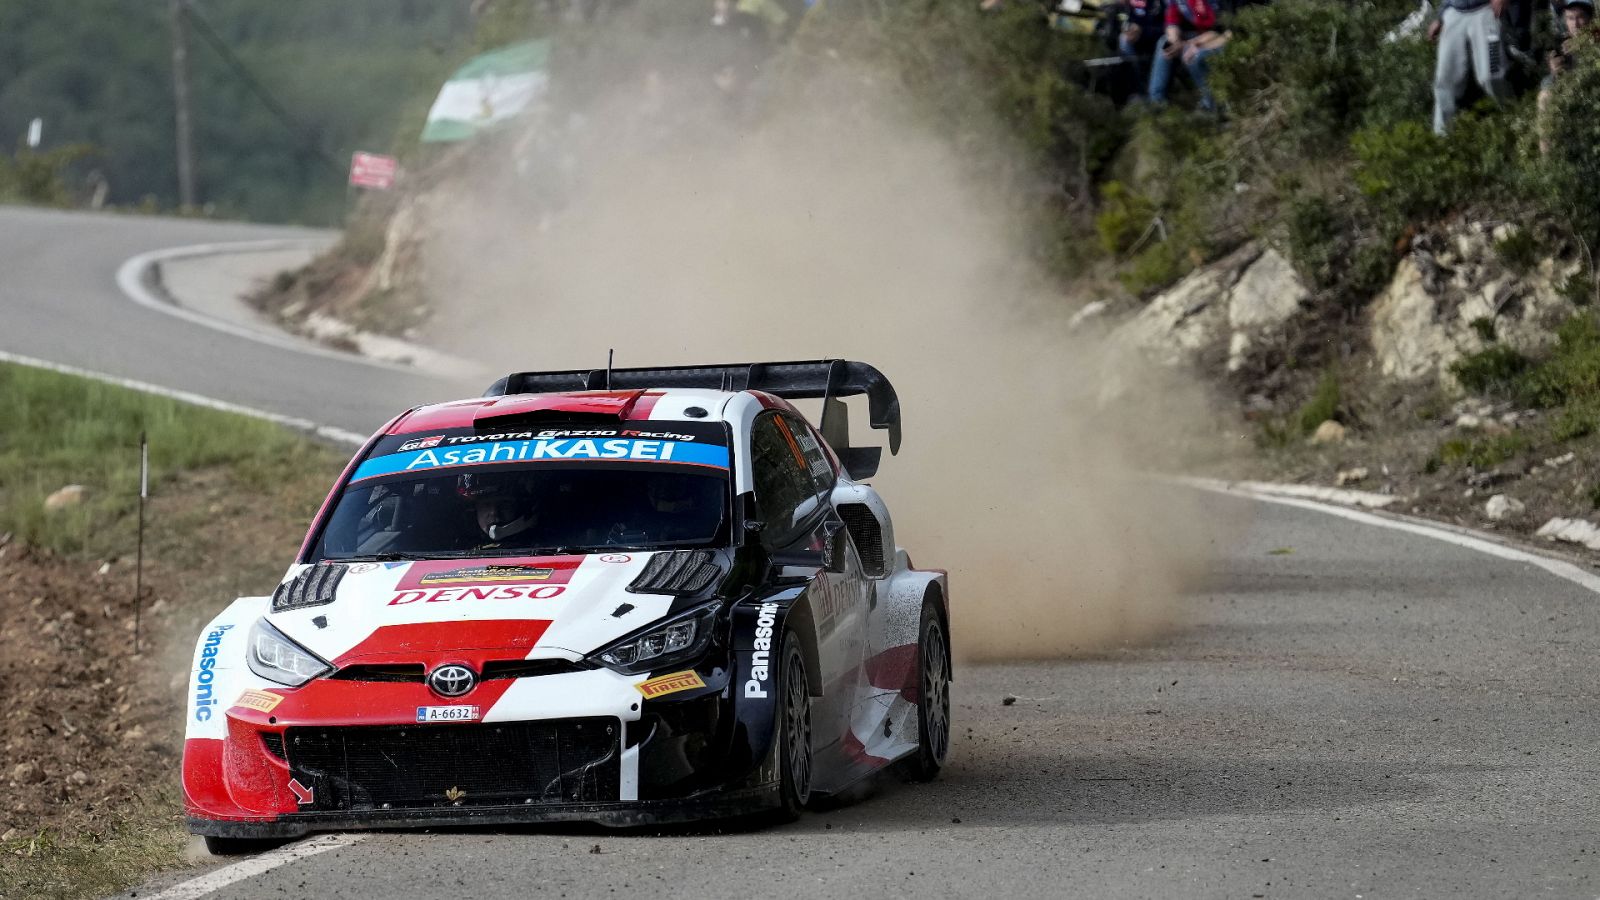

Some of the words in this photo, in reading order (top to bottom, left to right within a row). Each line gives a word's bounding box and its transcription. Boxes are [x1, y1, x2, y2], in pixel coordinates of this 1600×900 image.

[448, 432, 532, 443] TOYOTA
[533, 430, 618, 439] GAZOO
[621, 430, 696, 441] Racing
[387, 586, 566, 606] DENSO
[745, 603, 779, 699] Panasonic
[195, 624, 235, 722] Panasonic
[640, 672, 698, 696] PIRELLI
[236, 691, 277, 709] PIRELLI
[431, 708, 469, 719] A-6632
